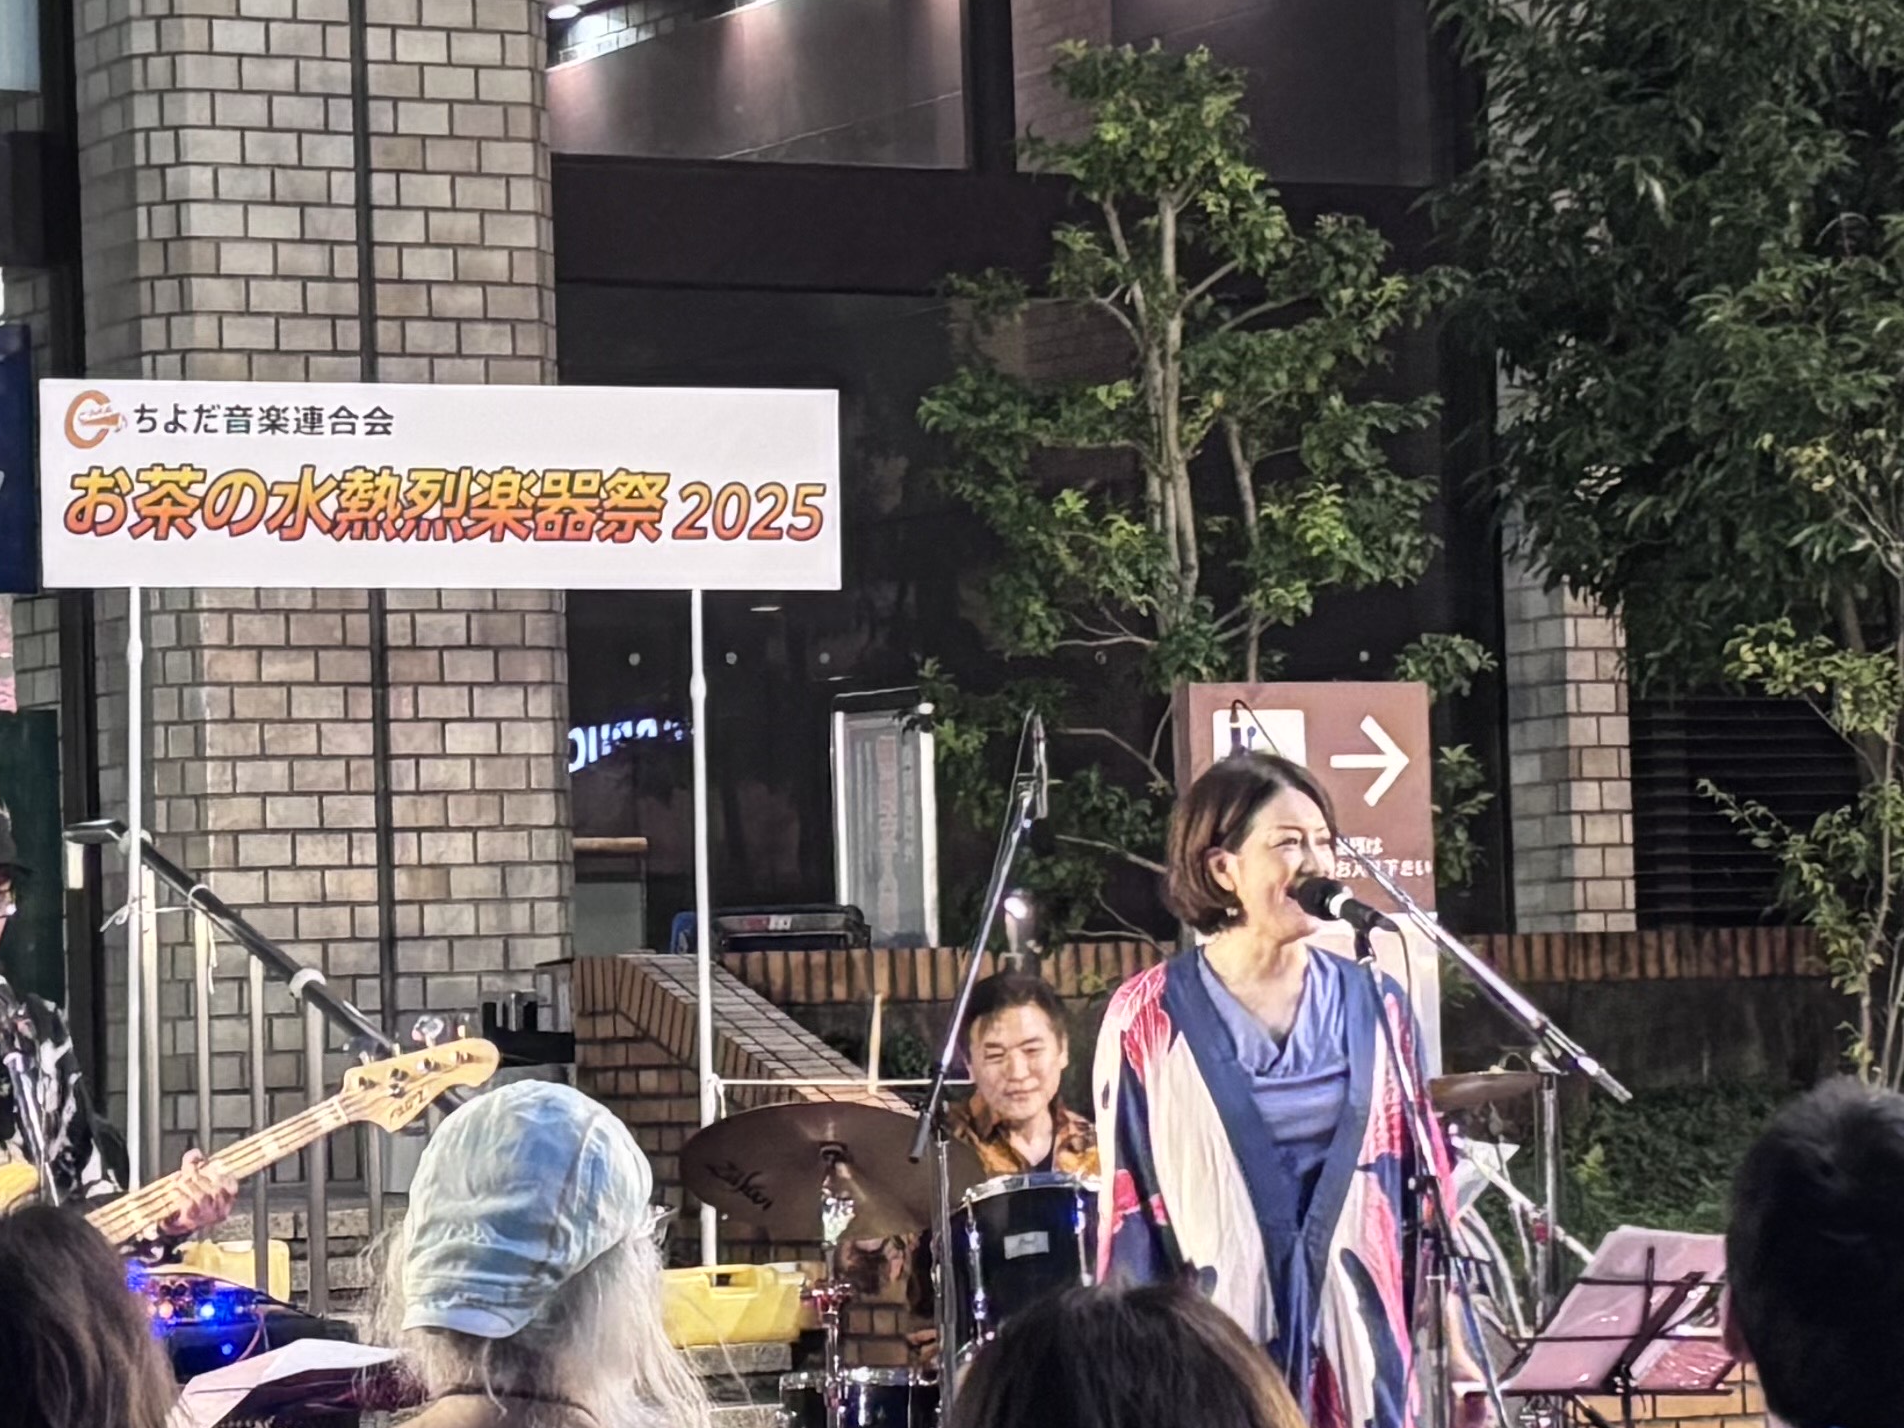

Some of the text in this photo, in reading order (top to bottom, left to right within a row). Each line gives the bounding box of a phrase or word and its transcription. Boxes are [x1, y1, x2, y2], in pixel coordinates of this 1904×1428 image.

[133, 403, 395, 437] ちよだ音楽連合会
